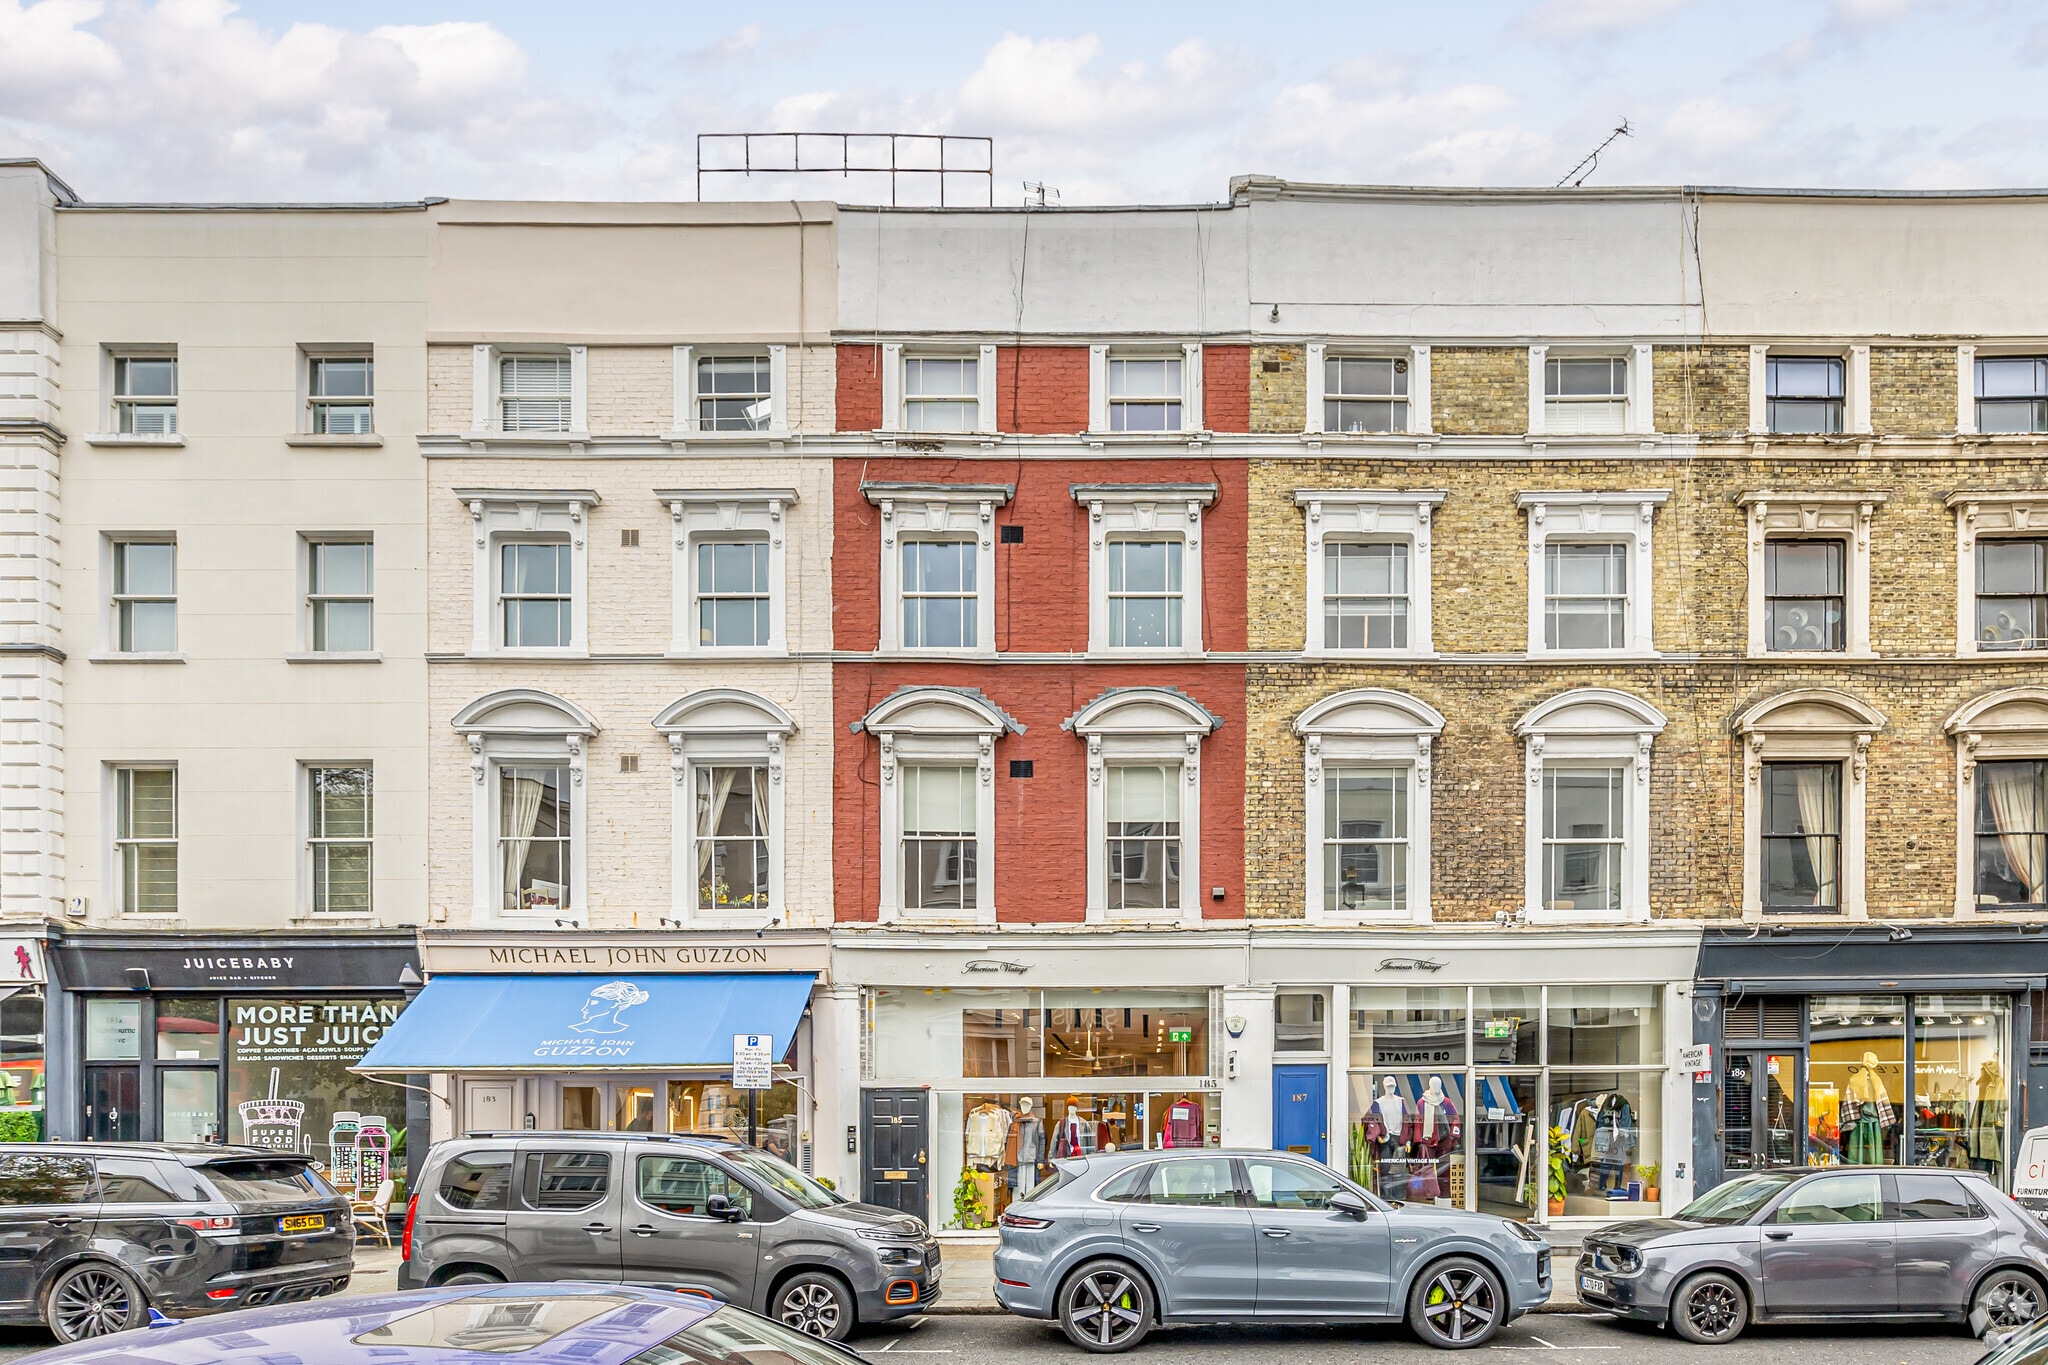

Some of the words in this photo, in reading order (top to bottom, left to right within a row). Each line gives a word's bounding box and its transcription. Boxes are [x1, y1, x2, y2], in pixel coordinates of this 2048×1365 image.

[490, 948, 596, 964] MICHAEL
[607, 948, 667, 967] JOHN
[676, 948, 767, 963] GUZZON
[183, 957, 294, 969] JUICEBABY
[961, 960, 998, 974] American
[1000, 960, 1029, 975] Vintage
[1375, 958, 1412, 972] American
[1414, 957, 1442, 973] Vintage
[236, 1006, 314, 1024] MORE
[324, 1005, 398, 1023] THAN
[236, 1026, 307, 1046] JUST
[540, 1038, 596, 1046] MICHAEL
[749, 1037, 758, 1046] P
[533, 1046, 630, 1057] GUZZON
[1682, 1049, 1703, 1058] AMERICAN
[1684, 1059, 1701, 1067] VINTAGE
[1731, 1068, 1745, 1078] 189
[1200, 1080, 1217, 1088] 185
[1292, 1093, 1308, 1102] 187
[890, 1115, 903, 1124] 185
[252, 1136, 293, 1144] FOOD
